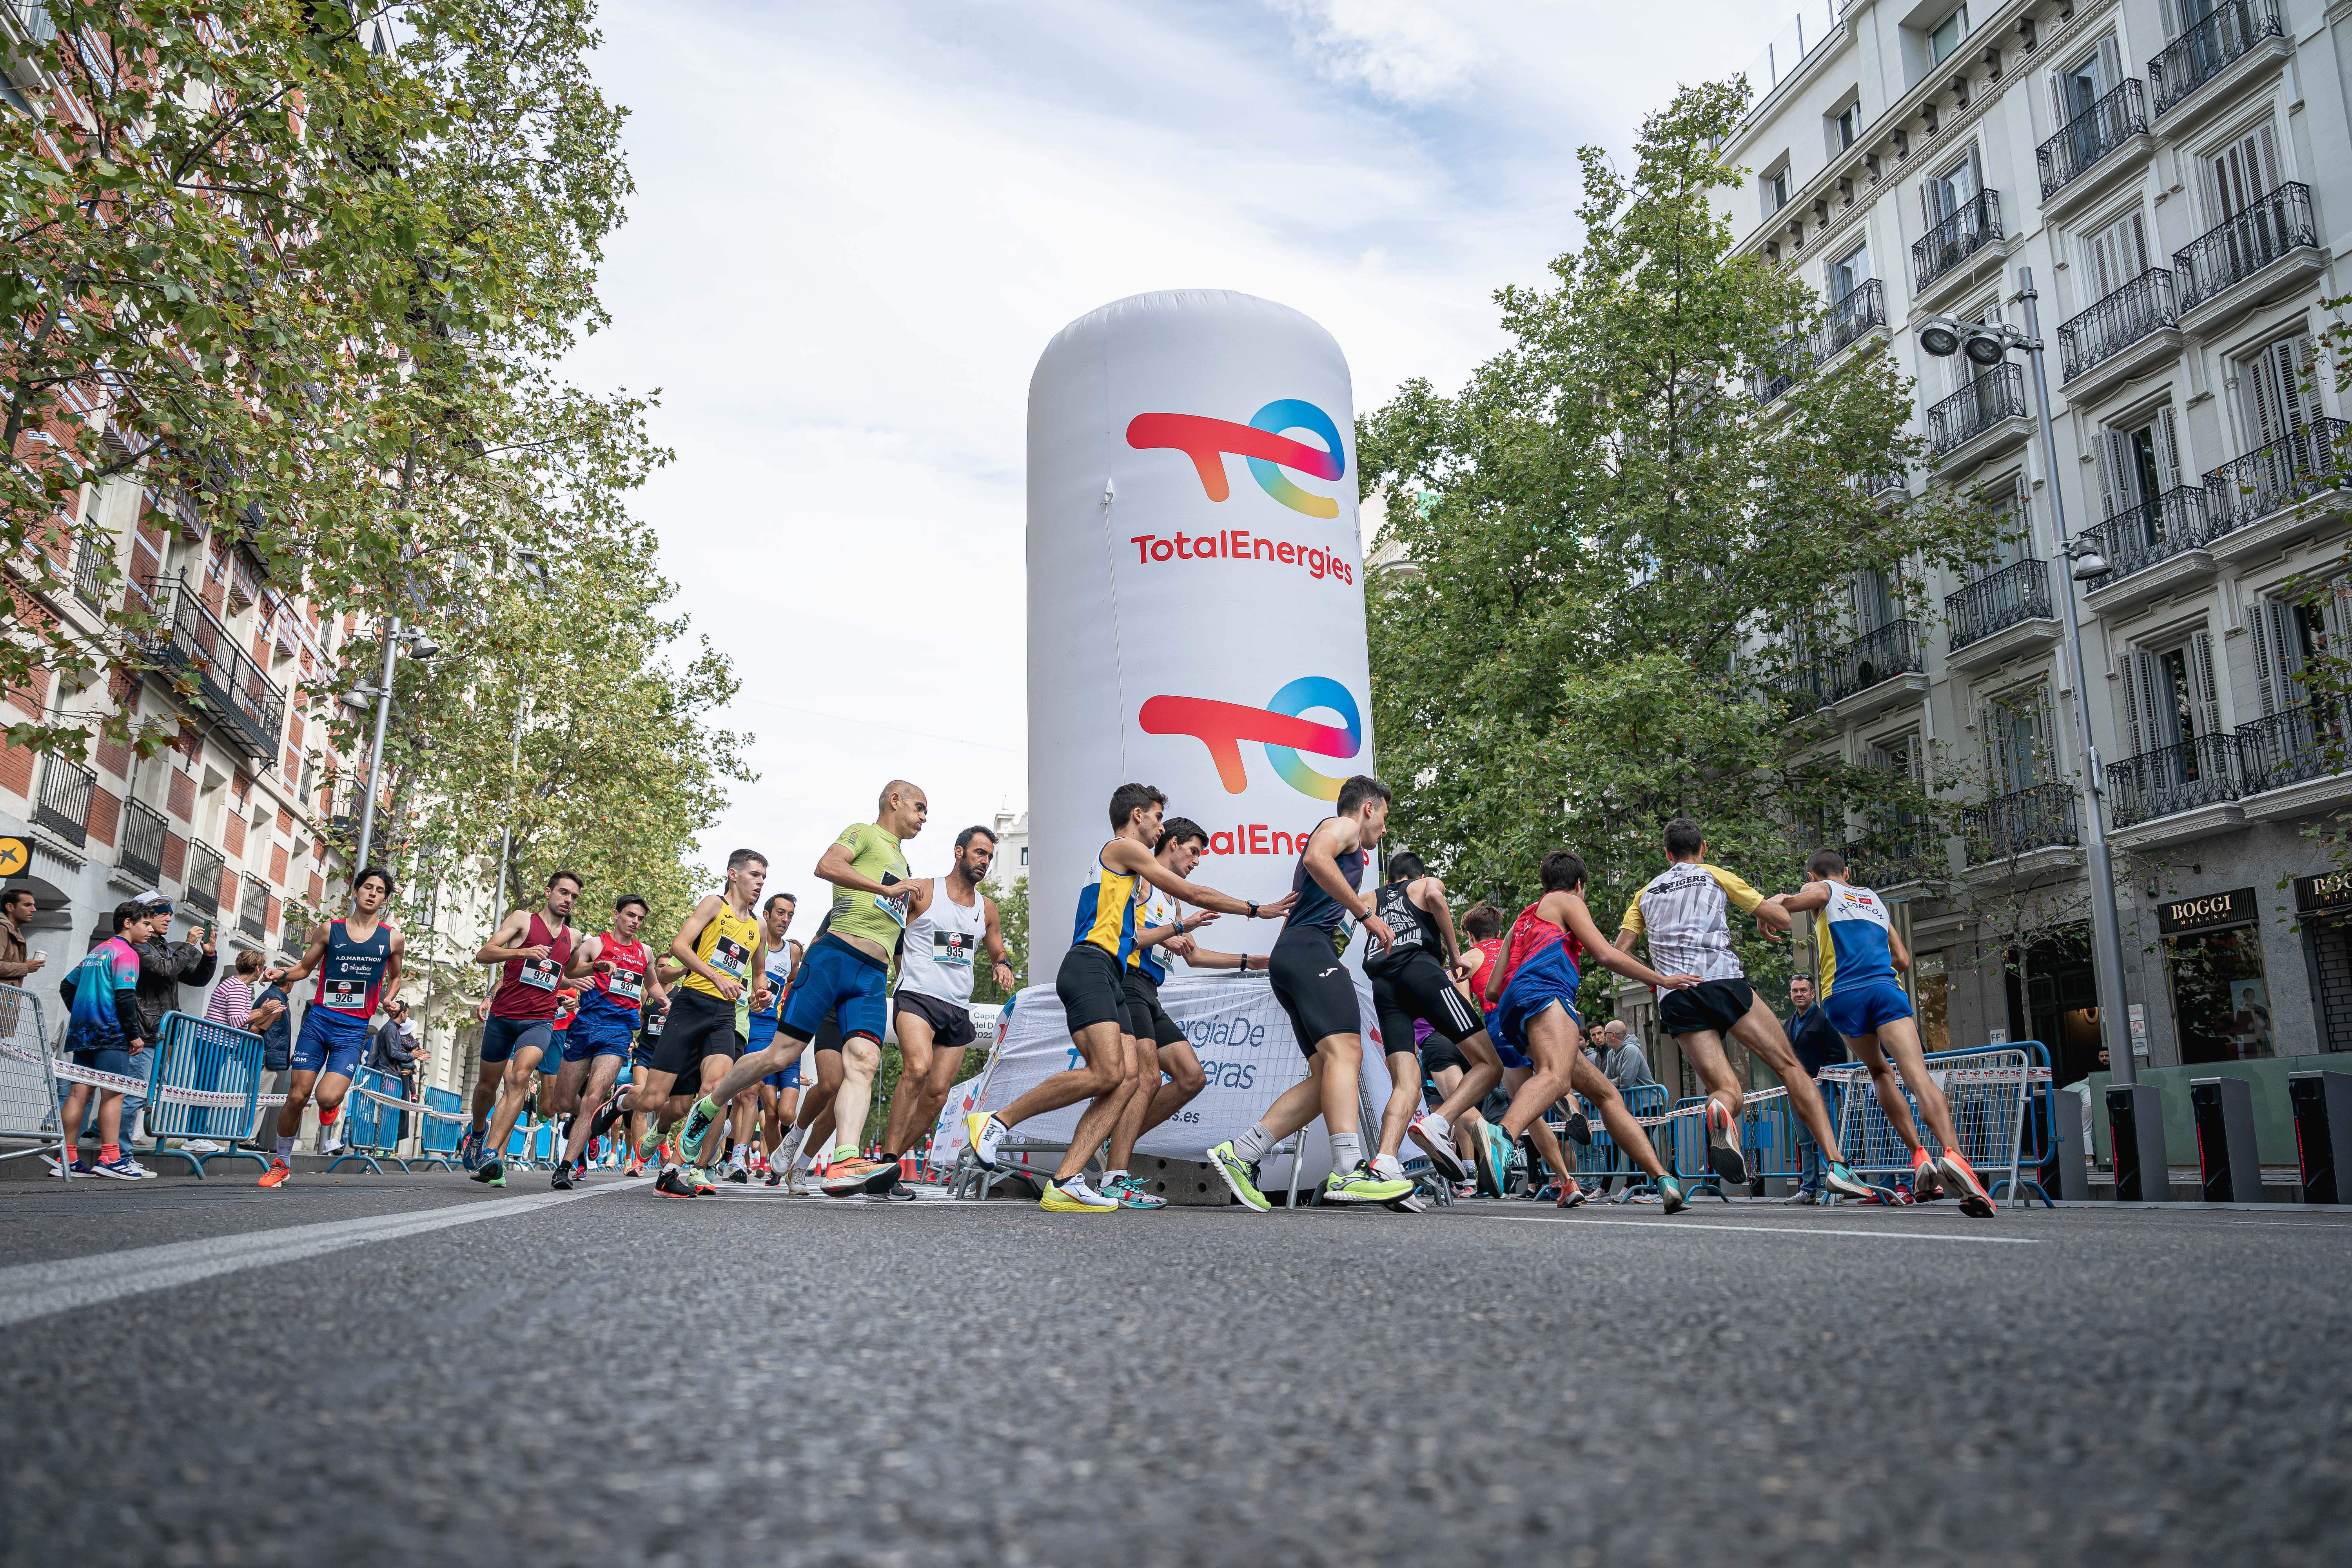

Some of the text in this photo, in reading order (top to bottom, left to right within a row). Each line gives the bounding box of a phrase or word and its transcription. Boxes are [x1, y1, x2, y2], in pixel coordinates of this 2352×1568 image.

[1131, 530, 1352, 586] TotalEnergies
[1669, 875, 1706, 888] TIGERS
[1669, 884, 1692, 893] RUNNING
[888, 897, 903, 915] 954
[1388, 896, 1408, 914] BERLIN
[1838, 902, 1884, 920] ALCORCÓN
[2171, 895, 2232, 920] BOGGI
[1389, 911, 1415, 924] BERLIN
[2180, 913, 2227, 925] MILANO
[946, 946, 963, 958] 935
[349, 964, 372, 973] alquiber
[722, 954, 738, 970] 939
[533, 970, 551, 983] 928
[621, 982, 633, 992] 937
[336, 993, 353, 1002] 926
[1991, 1033, 2000, 1042] FF
